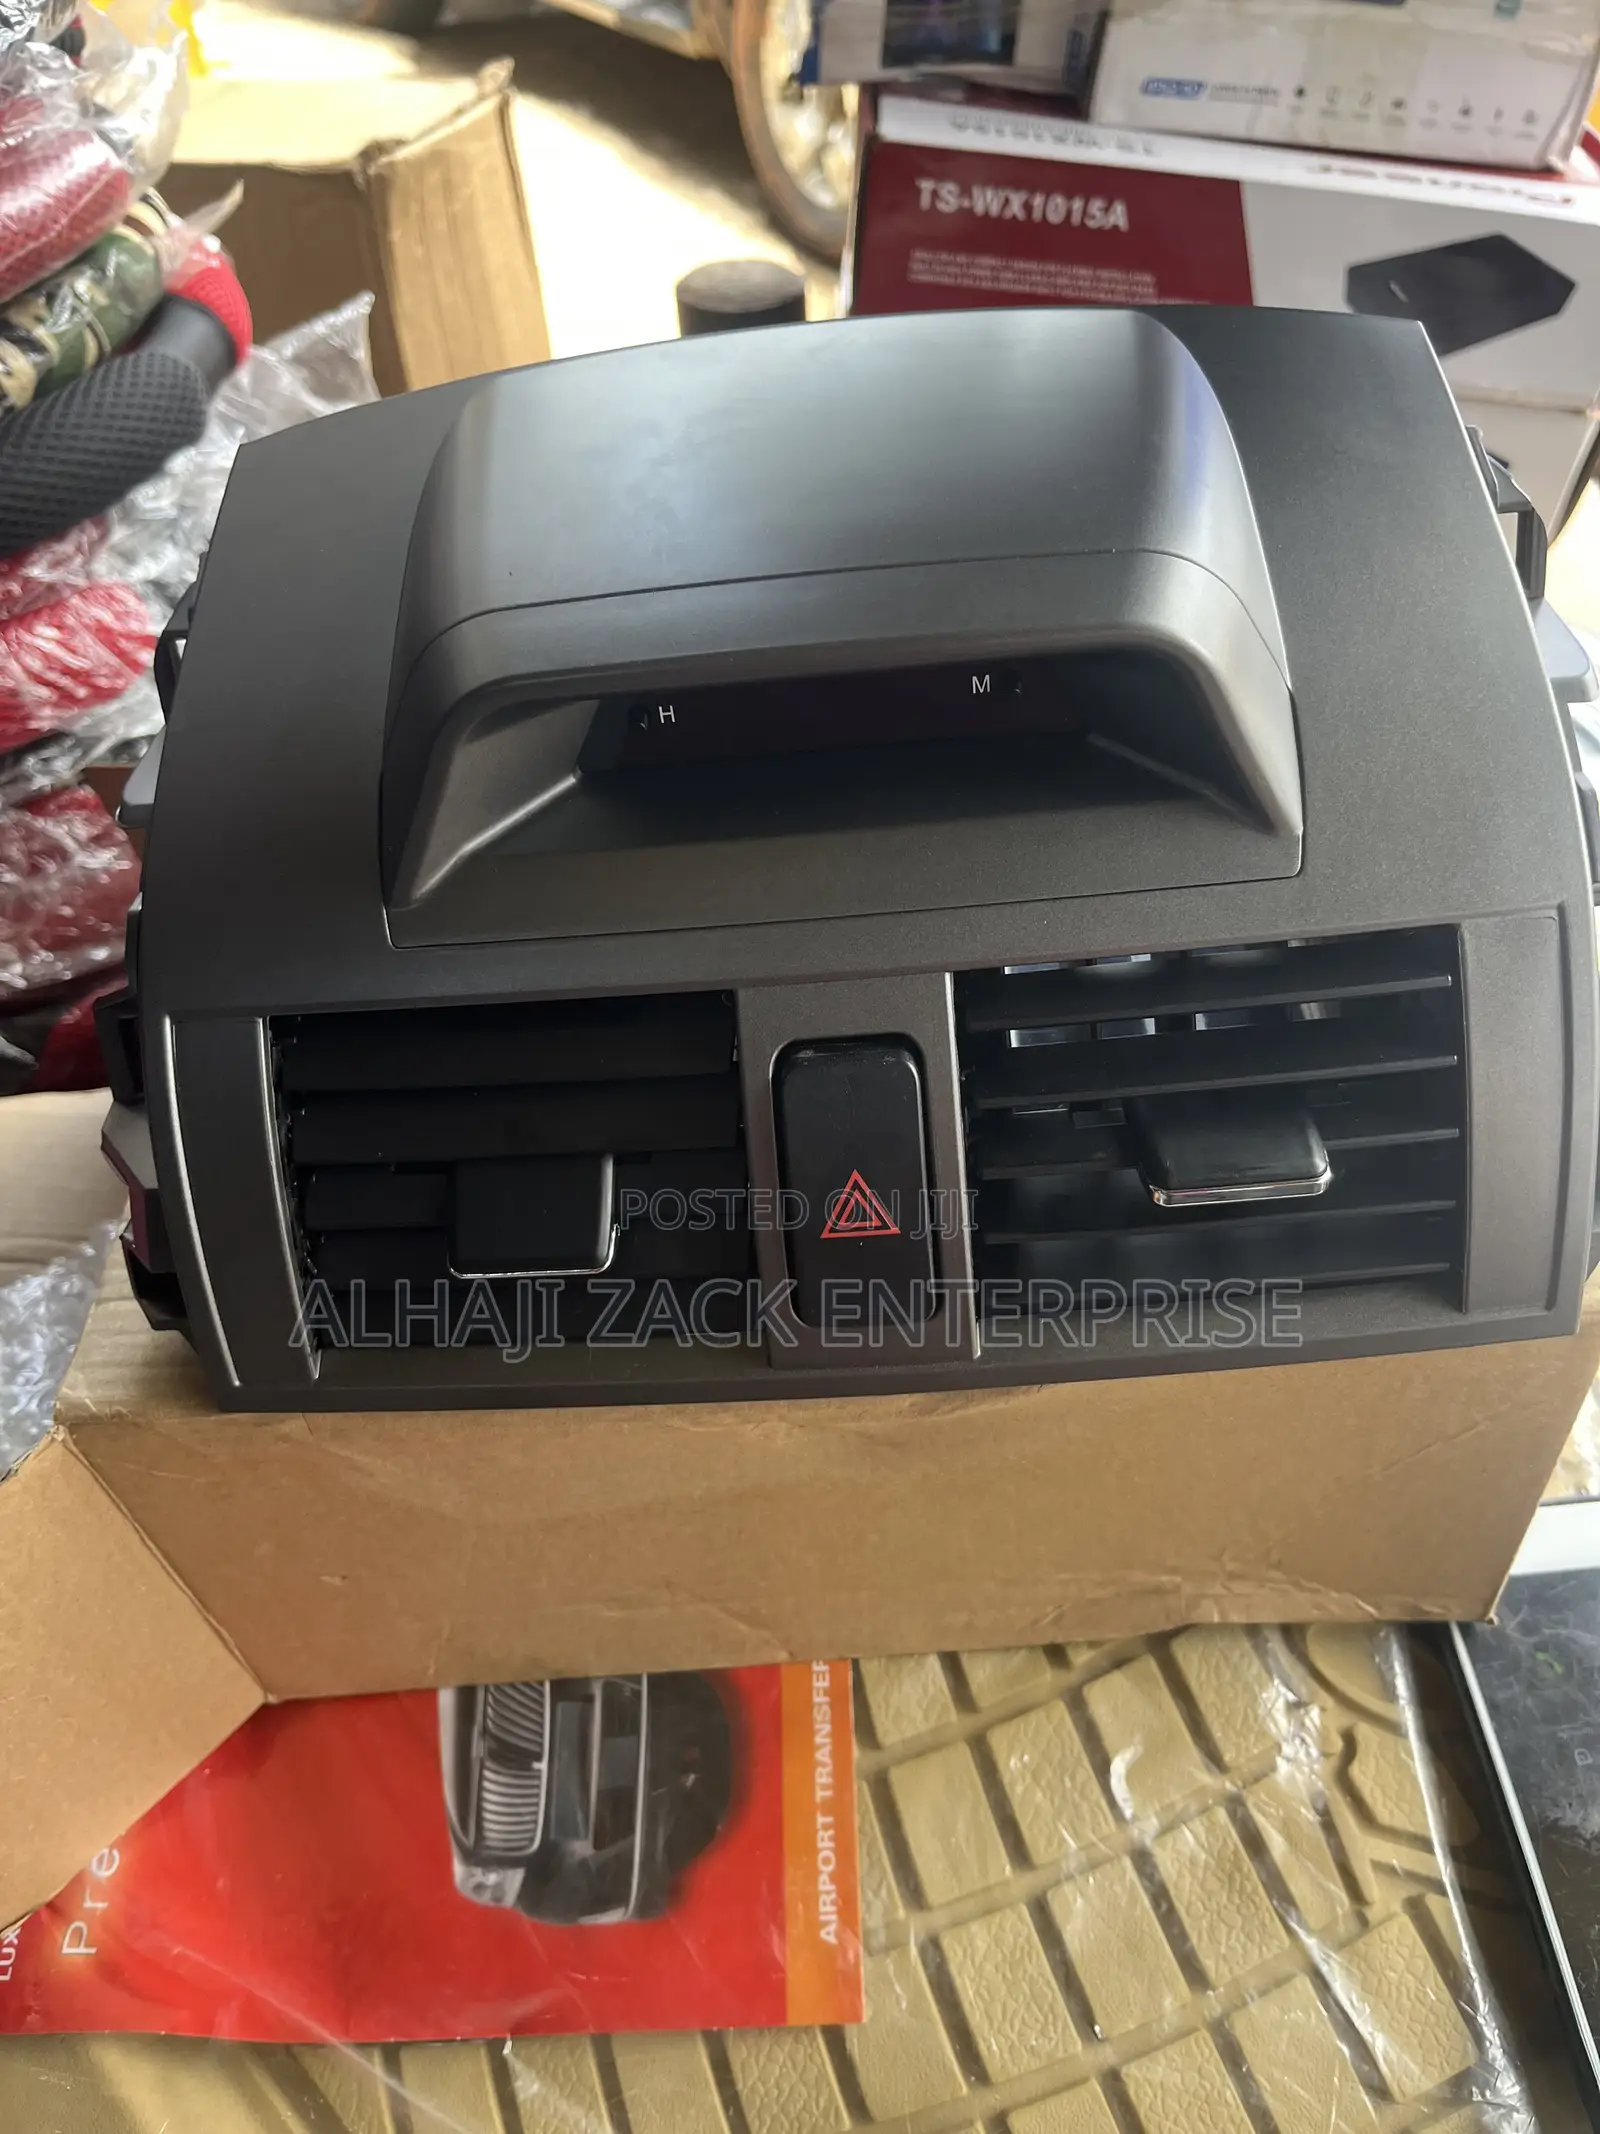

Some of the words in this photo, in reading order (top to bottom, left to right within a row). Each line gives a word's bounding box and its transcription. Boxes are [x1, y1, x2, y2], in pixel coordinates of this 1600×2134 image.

[914, 177, 1130, 232] TS-WX1015A
[972, 674, 991, 694] M
[658, 704, 676, 724] H
[816, 1811, 839, 1945] AIRPORT
